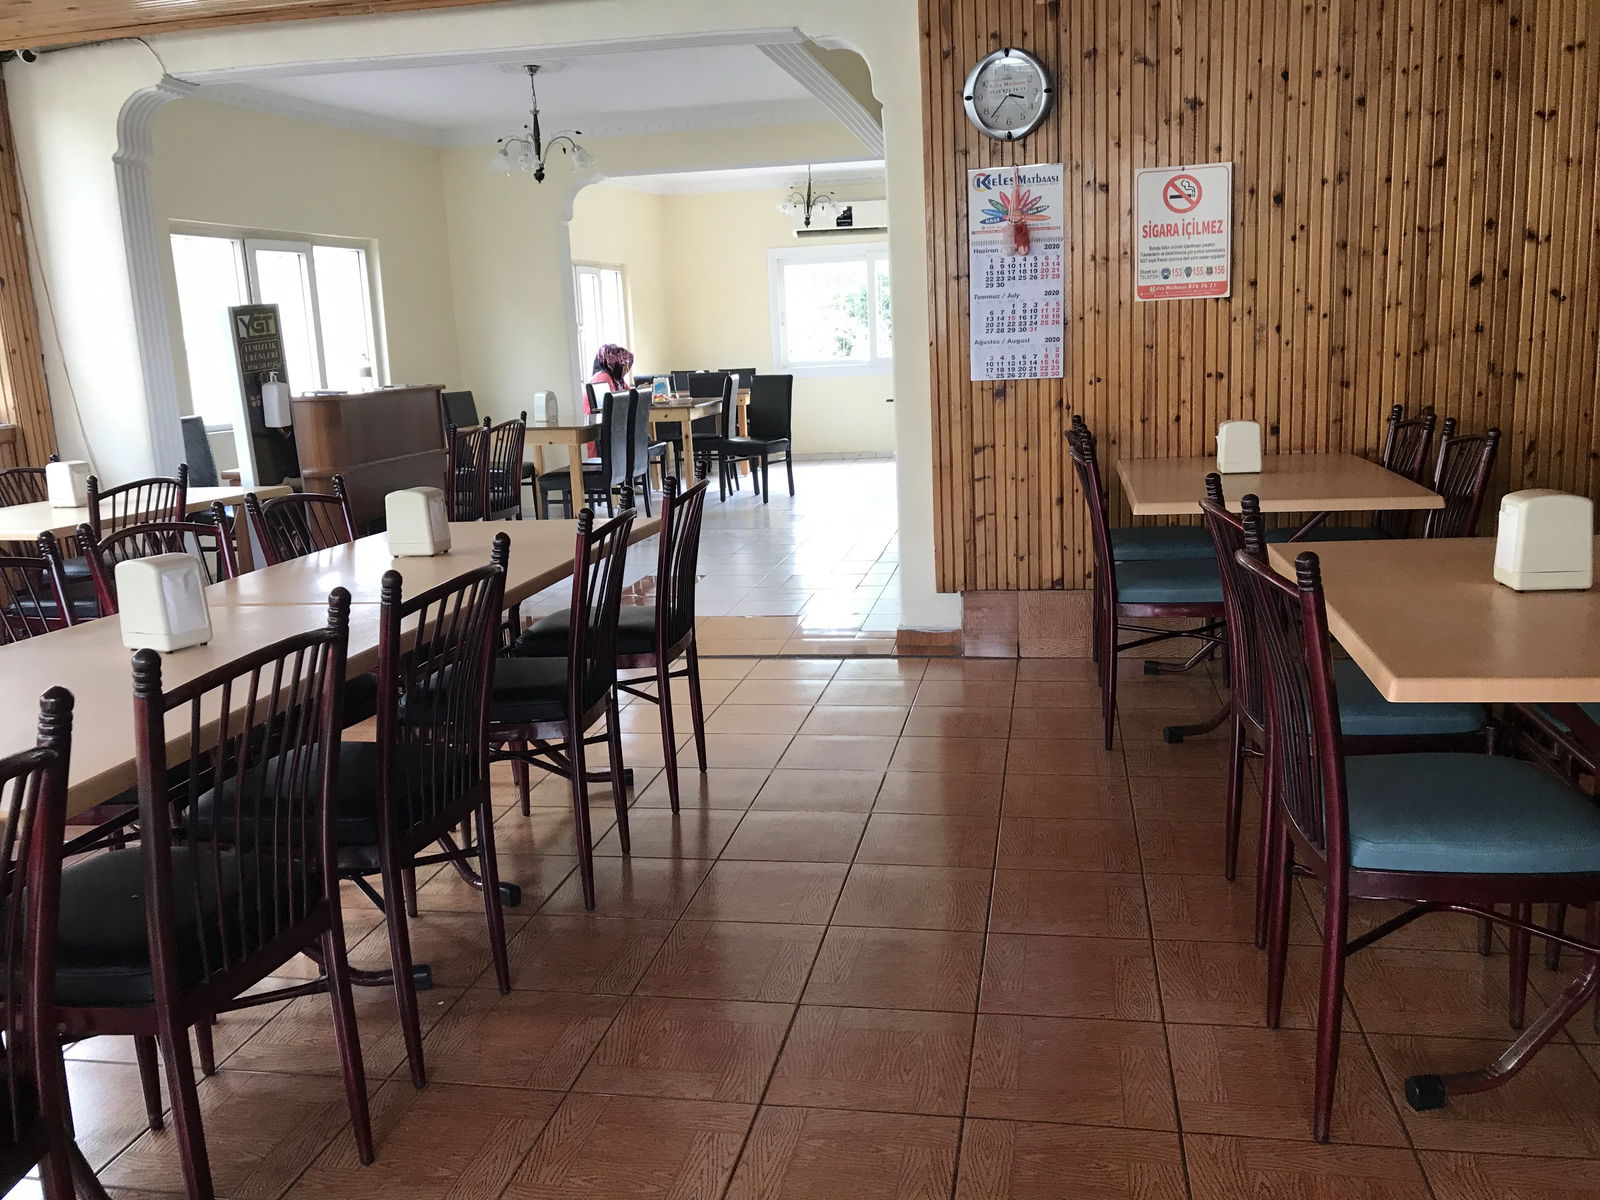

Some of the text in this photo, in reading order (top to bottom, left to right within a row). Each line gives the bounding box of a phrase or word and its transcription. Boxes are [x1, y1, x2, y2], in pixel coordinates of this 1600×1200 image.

[1142, 218, 1224, 240] SİGARA İÇİLMEZ
[1193, 266, 1204, 276] 155
